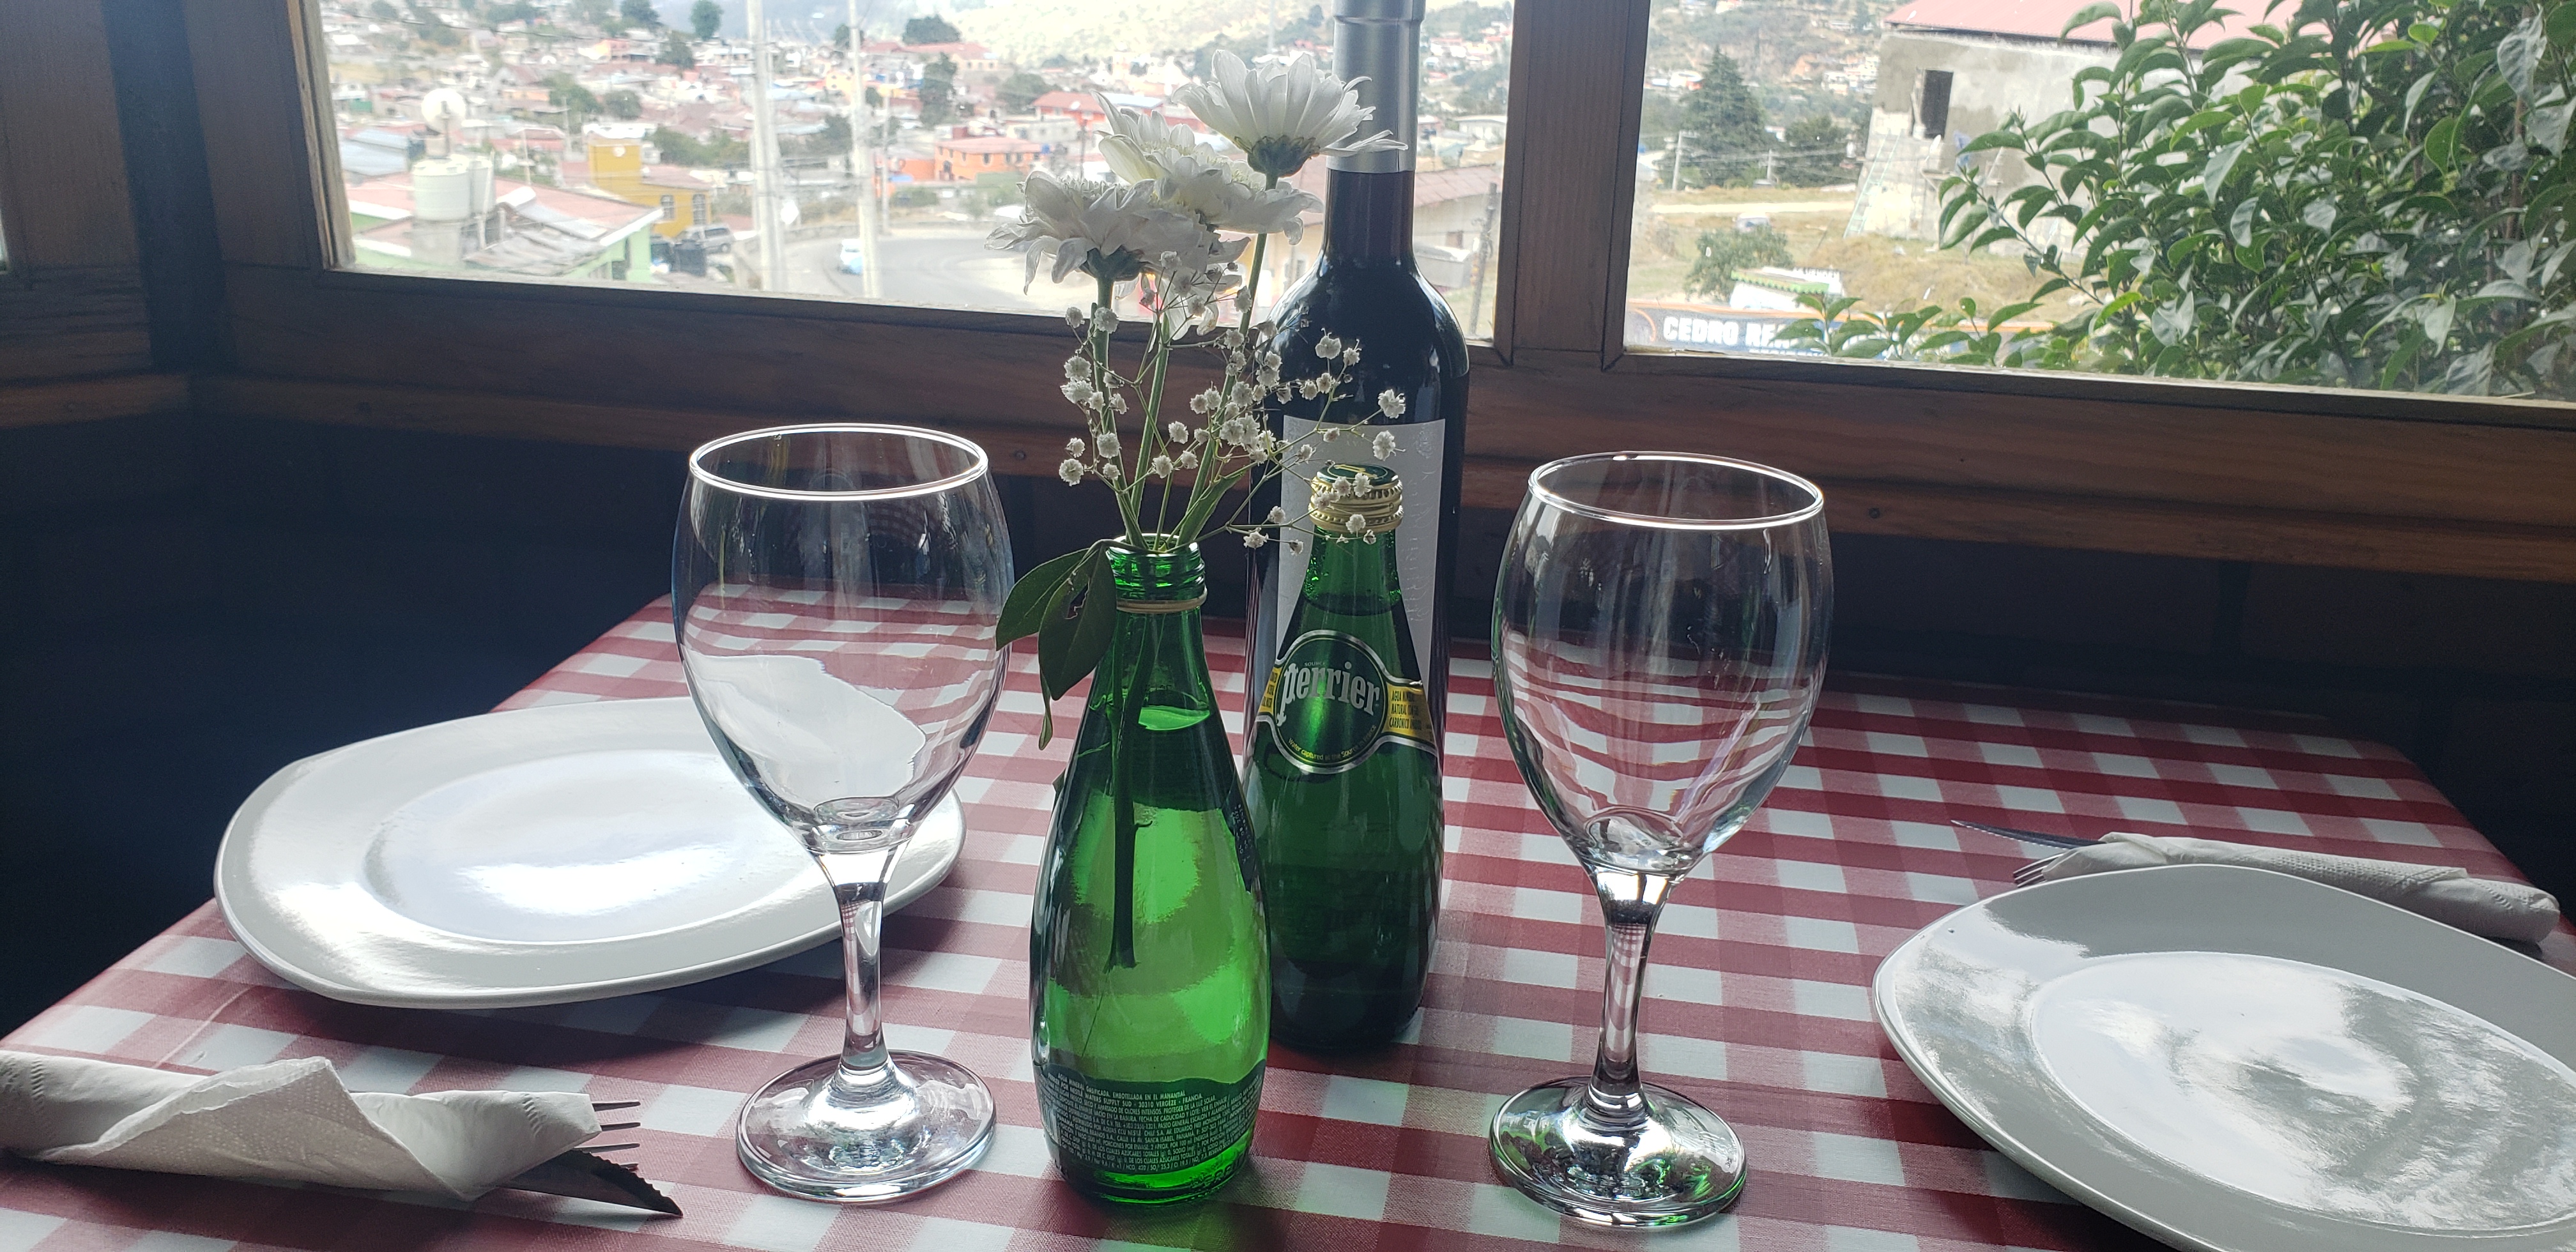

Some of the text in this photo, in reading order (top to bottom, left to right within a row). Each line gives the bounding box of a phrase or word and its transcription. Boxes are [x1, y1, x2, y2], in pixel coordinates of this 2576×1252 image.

[1662, 316, 1738, 346] CEDRO
[1276, 661, 1380, 727] perrier
[1085, 1093, 1101, 1103] WATERS
[1112, 1092, 1142, 1100] EMBOTELLADA
